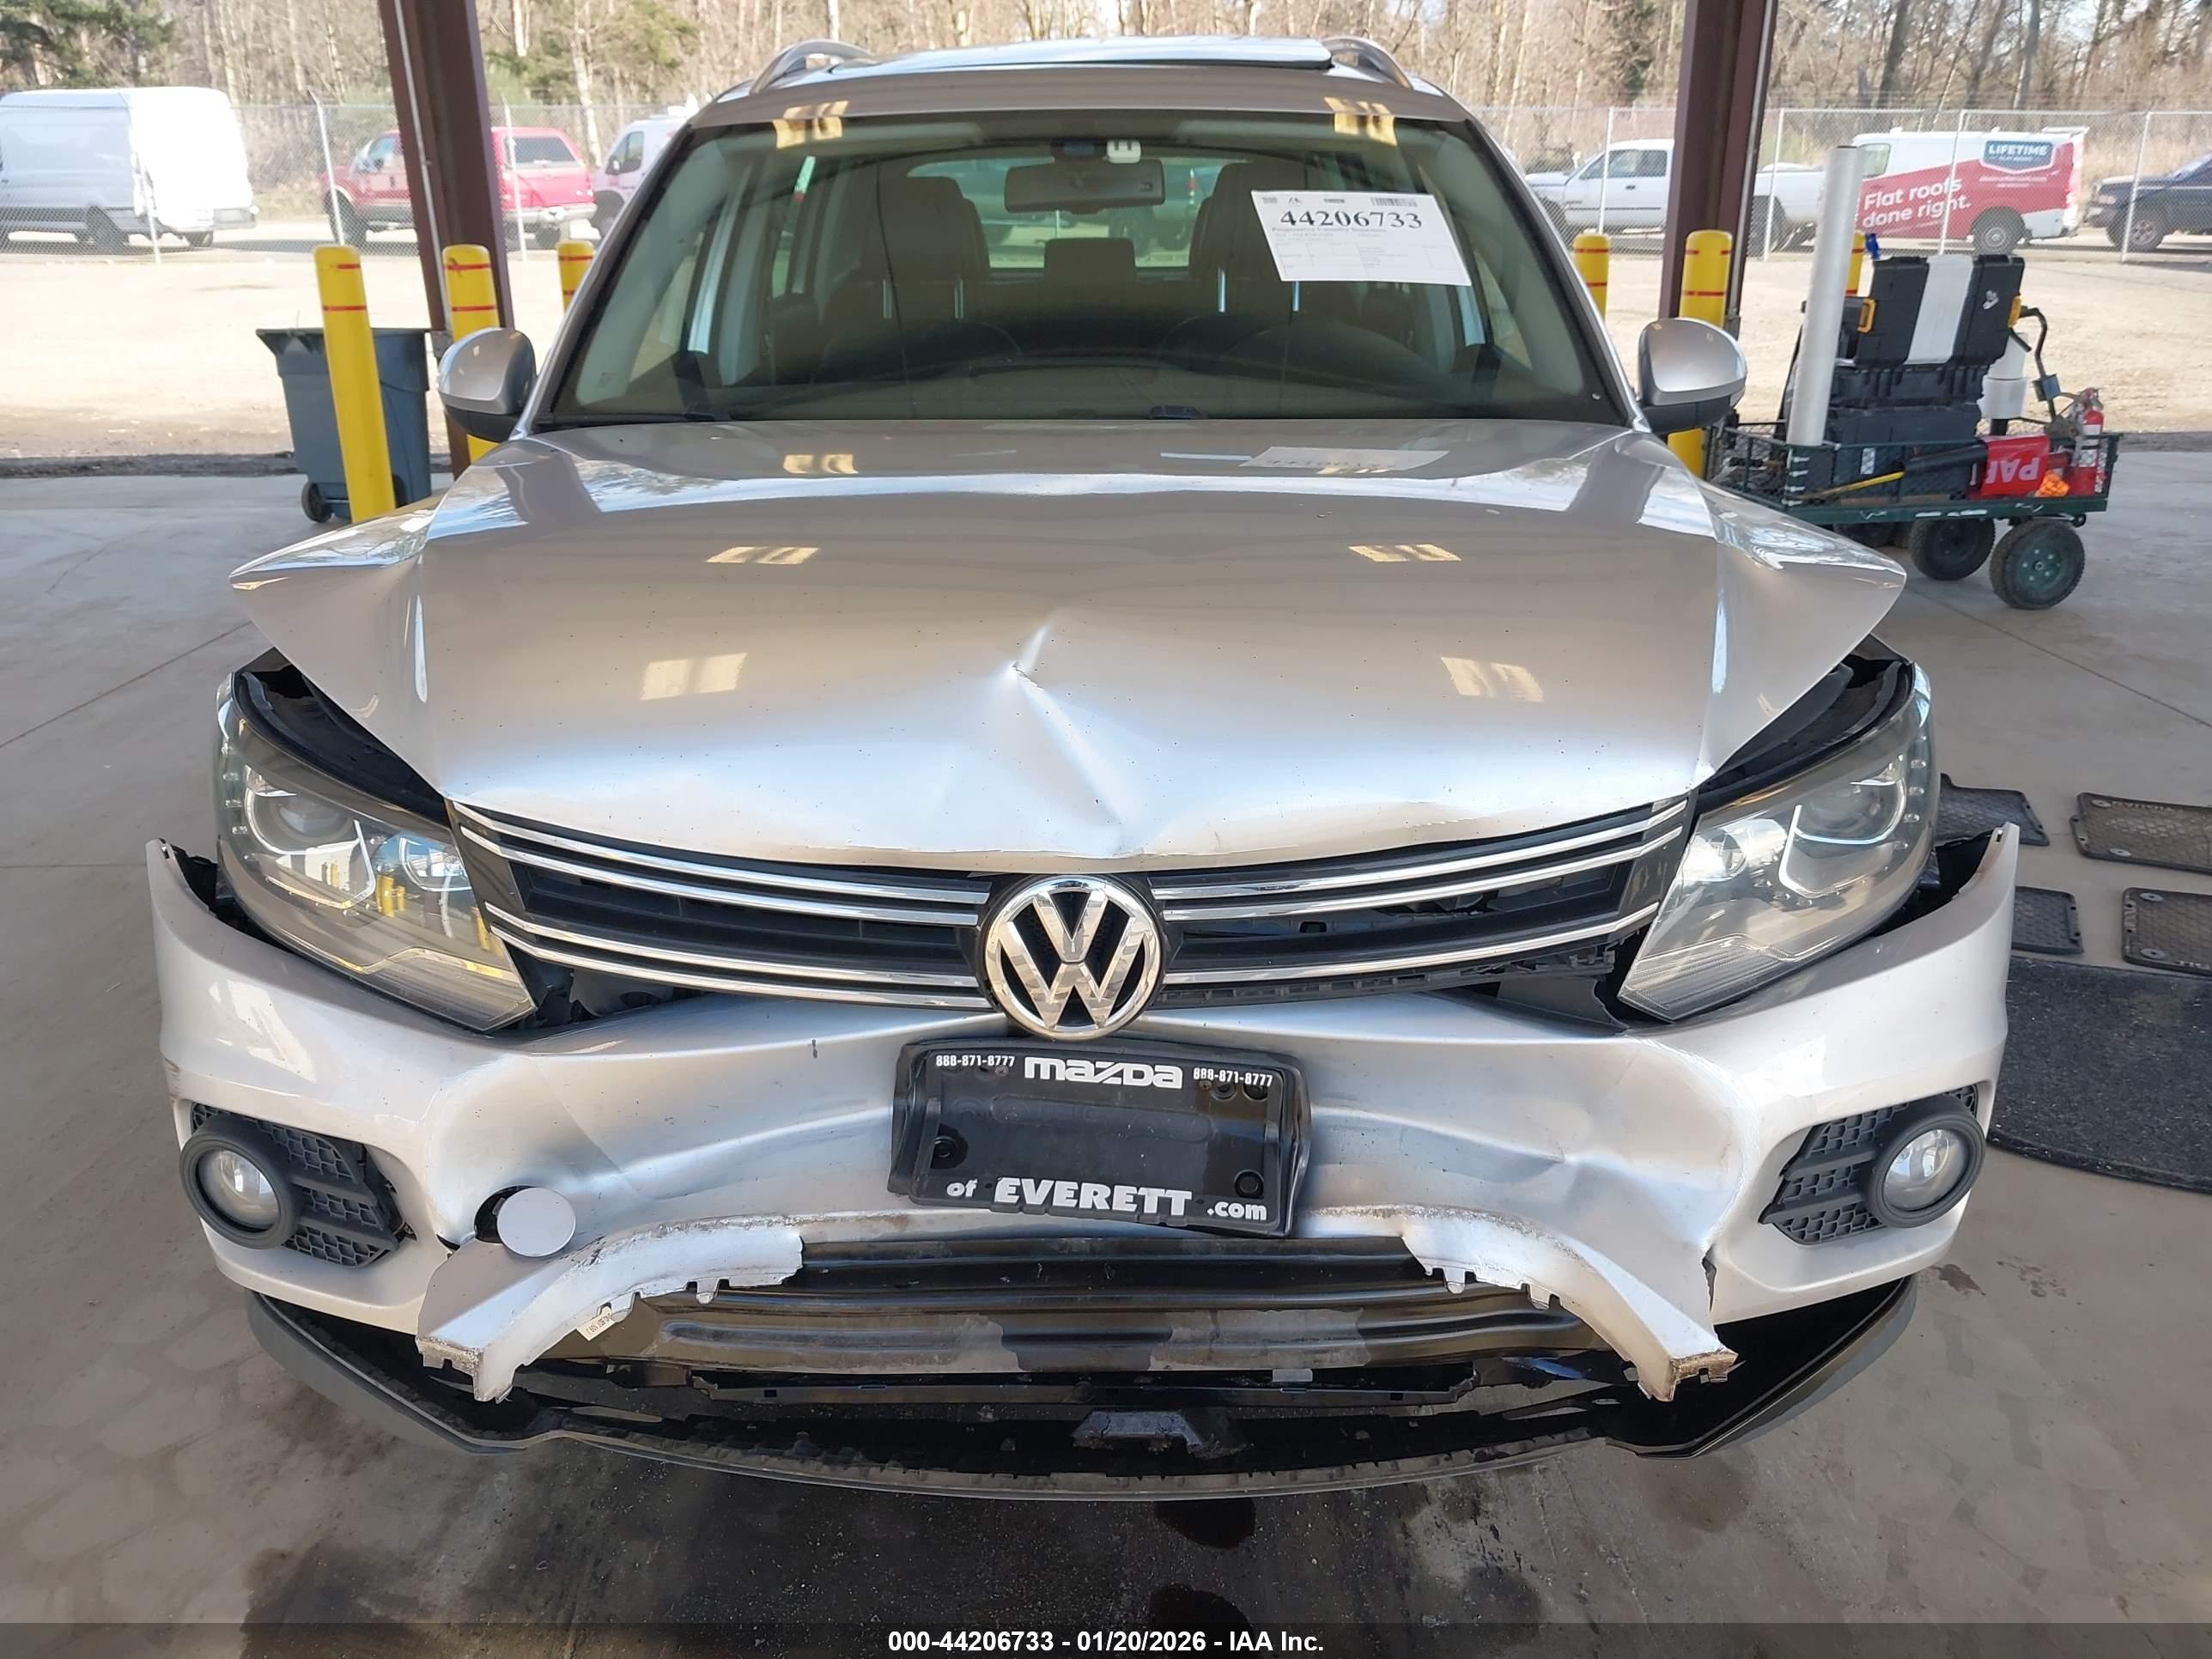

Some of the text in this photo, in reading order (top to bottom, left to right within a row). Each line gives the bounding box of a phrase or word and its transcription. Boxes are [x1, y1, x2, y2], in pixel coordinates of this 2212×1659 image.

[1988, 144, 2048, 155] LIFETIME
[1864, 177, 1963, 210] Flat roofs
[1280, 210, 1422, 229] 44206733
[1863, 207, 1913, 228] done
[936, 1055, 1016, 1066] 888-871-8777
[1193, 1067, 1273, 1086] 888-871-8777
[946, 1177, 1267, 1221] of EVERETT .com
